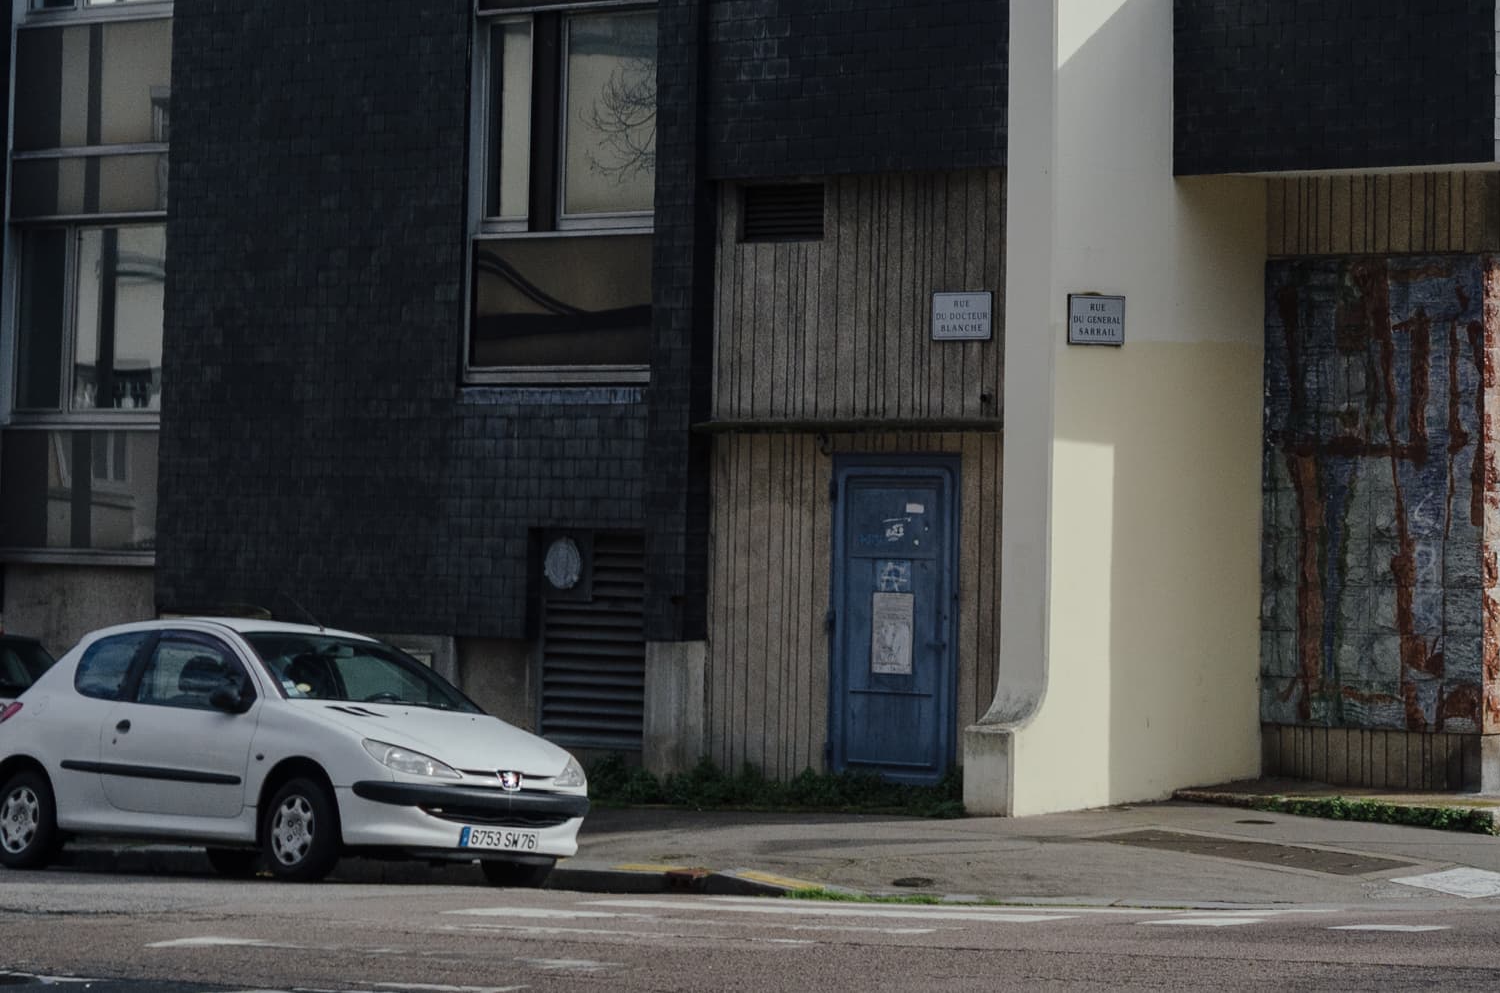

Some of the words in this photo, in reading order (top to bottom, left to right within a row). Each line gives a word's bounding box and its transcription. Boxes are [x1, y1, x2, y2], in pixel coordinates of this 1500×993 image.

[953, 300, 969, 308] RUE
[1089, 303, 1106, 311] RUE
[936, 312, 946, 320] DU
[949, 312, 987, 320] DOCTEUR
[1073, 315, 1084, 323] DU
[940, 324, 983, 332] BLANCHE
[1079, 327, 1116, 336] SARRAIL
[471, 830, 502, 846] 6753
[504, 832, 520, 848] SW
[521, 834, 536, 849] 76
